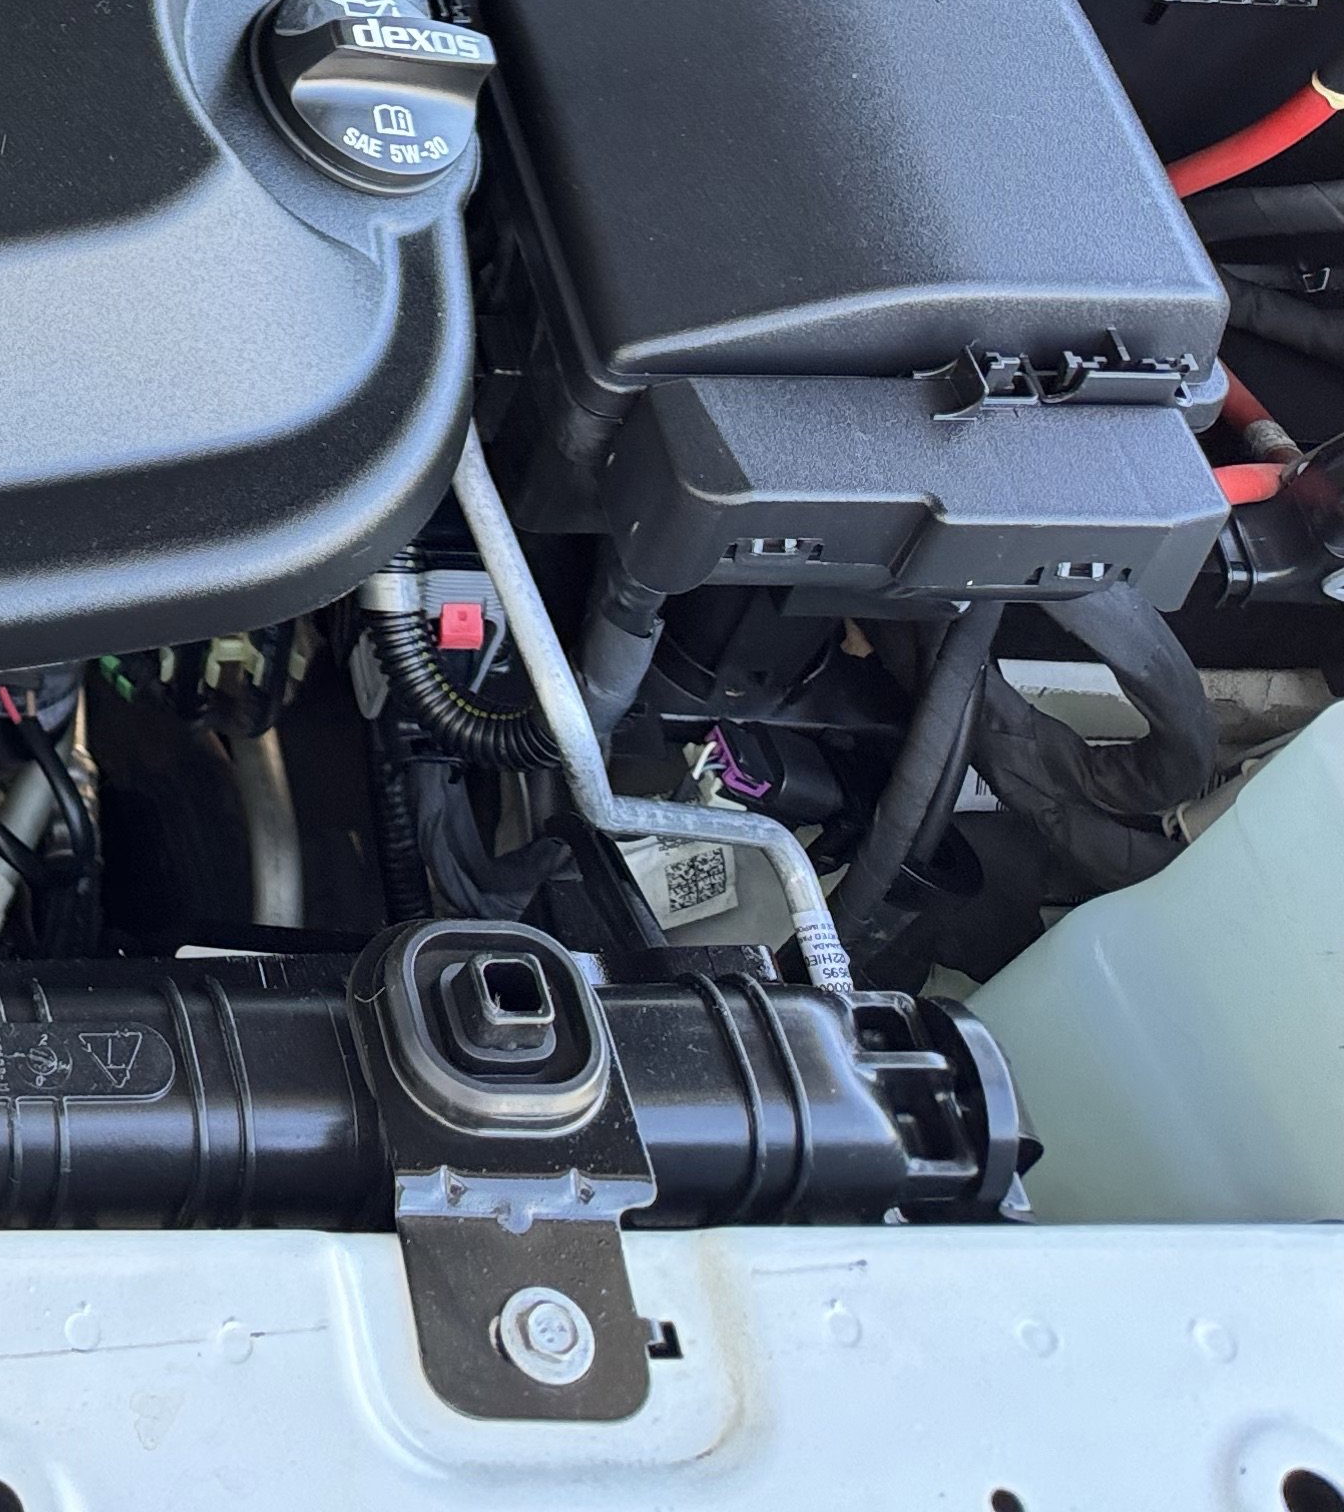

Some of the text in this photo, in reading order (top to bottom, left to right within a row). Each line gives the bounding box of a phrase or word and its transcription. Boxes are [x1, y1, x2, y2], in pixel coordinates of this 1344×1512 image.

[351, 18, 481, 60] dexos
[343, 126, 449, 164] SAE 5W-30
